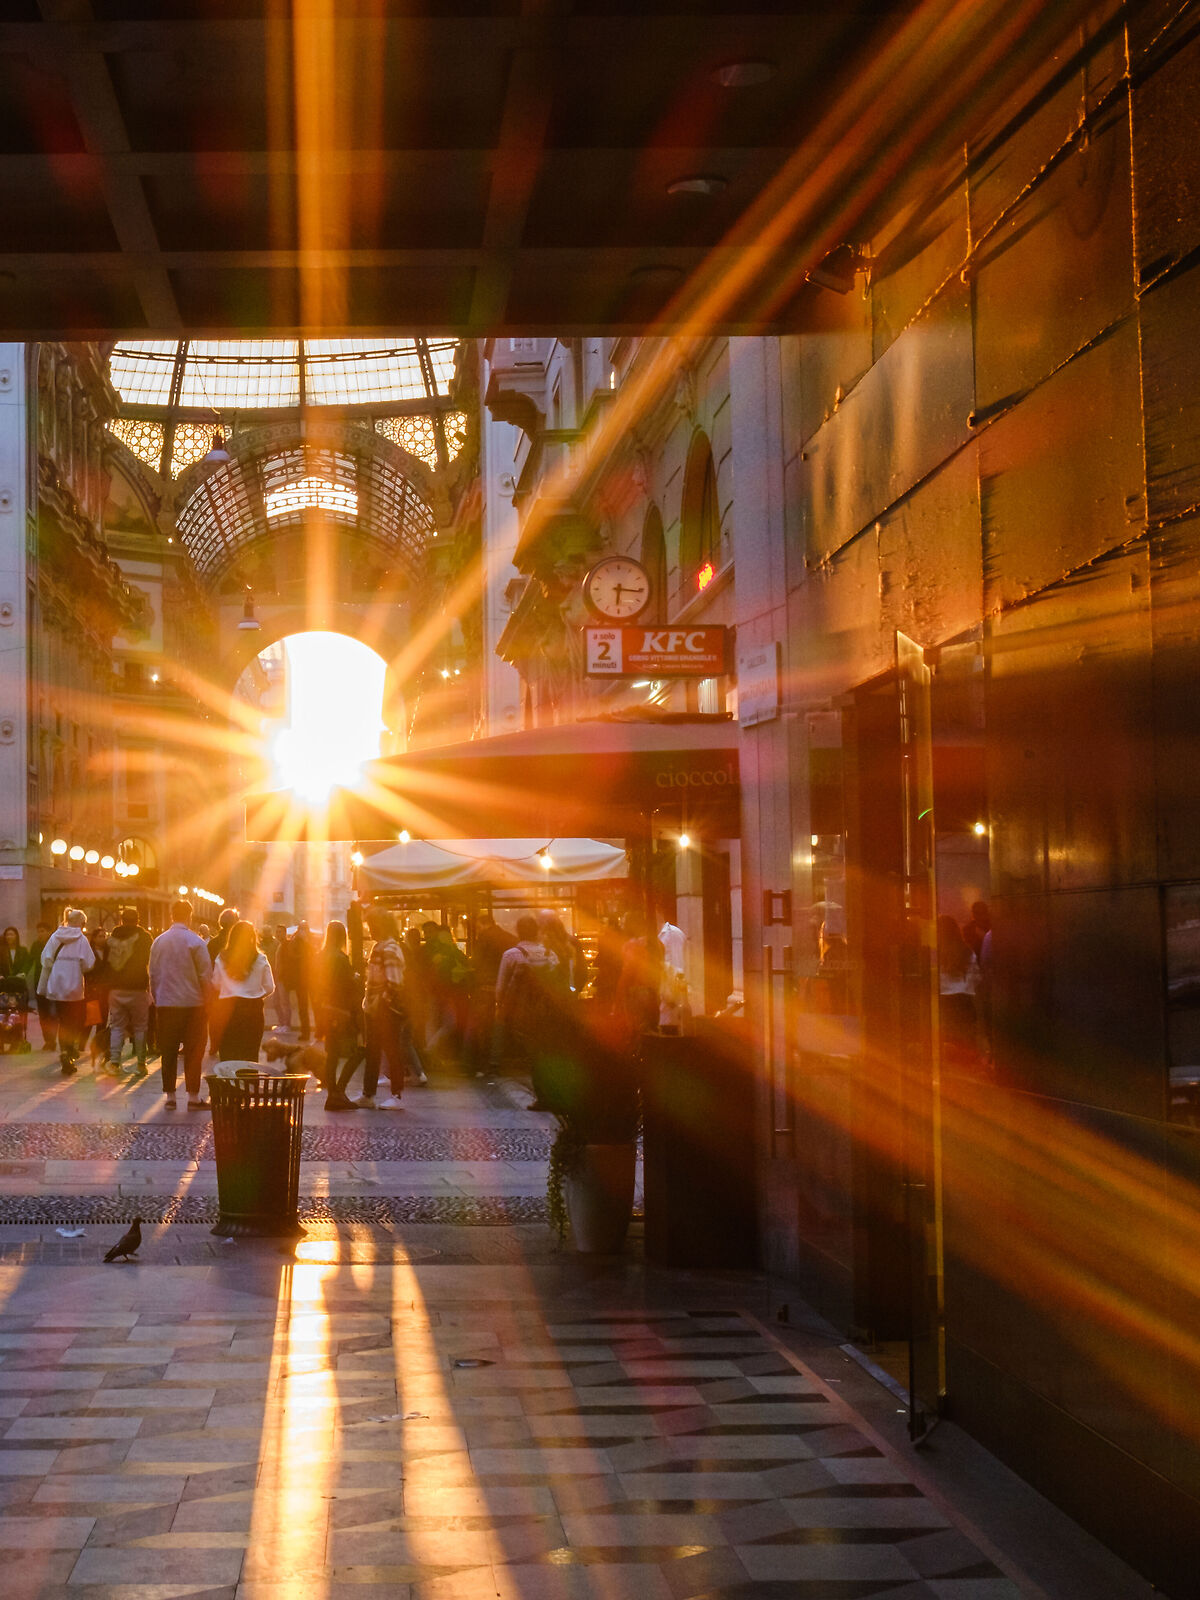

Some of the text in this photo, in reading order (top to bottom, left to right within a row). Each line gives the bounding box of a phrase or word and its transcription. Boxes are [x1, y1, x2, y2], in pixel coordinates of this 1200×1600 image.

[599, 632, 616, 640] solo
[640, 631, 706, 653] KFC
[597, 641, 612, 661] 2
[592, 661, 617, 669] minuti
[655, 762, 739, 788] cioccol
